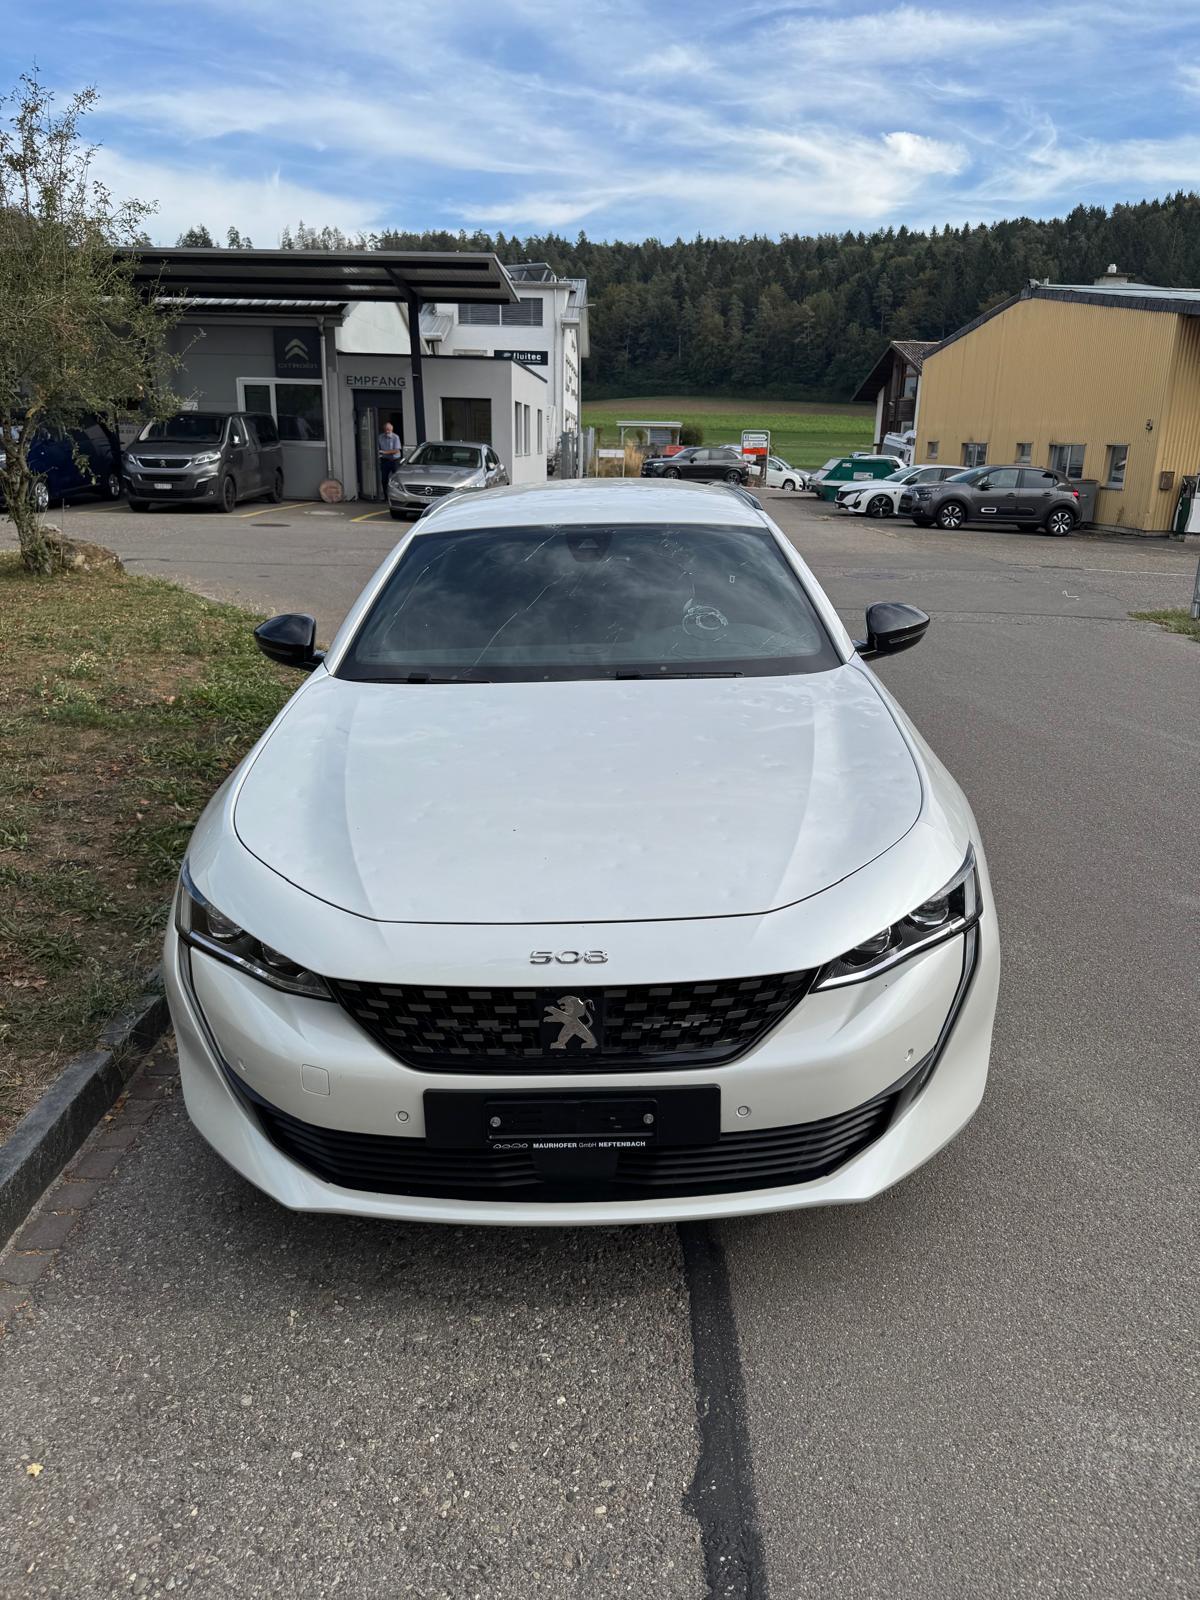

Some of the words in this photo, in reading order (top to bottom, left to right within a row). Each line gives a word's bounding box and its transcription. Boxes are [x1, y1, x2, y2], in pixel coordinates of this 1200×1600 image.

[513, 352, 542, 360] fluitec
[346, 375, 406, 387] EMPFANG
[530, 950, 609, 965] 508
